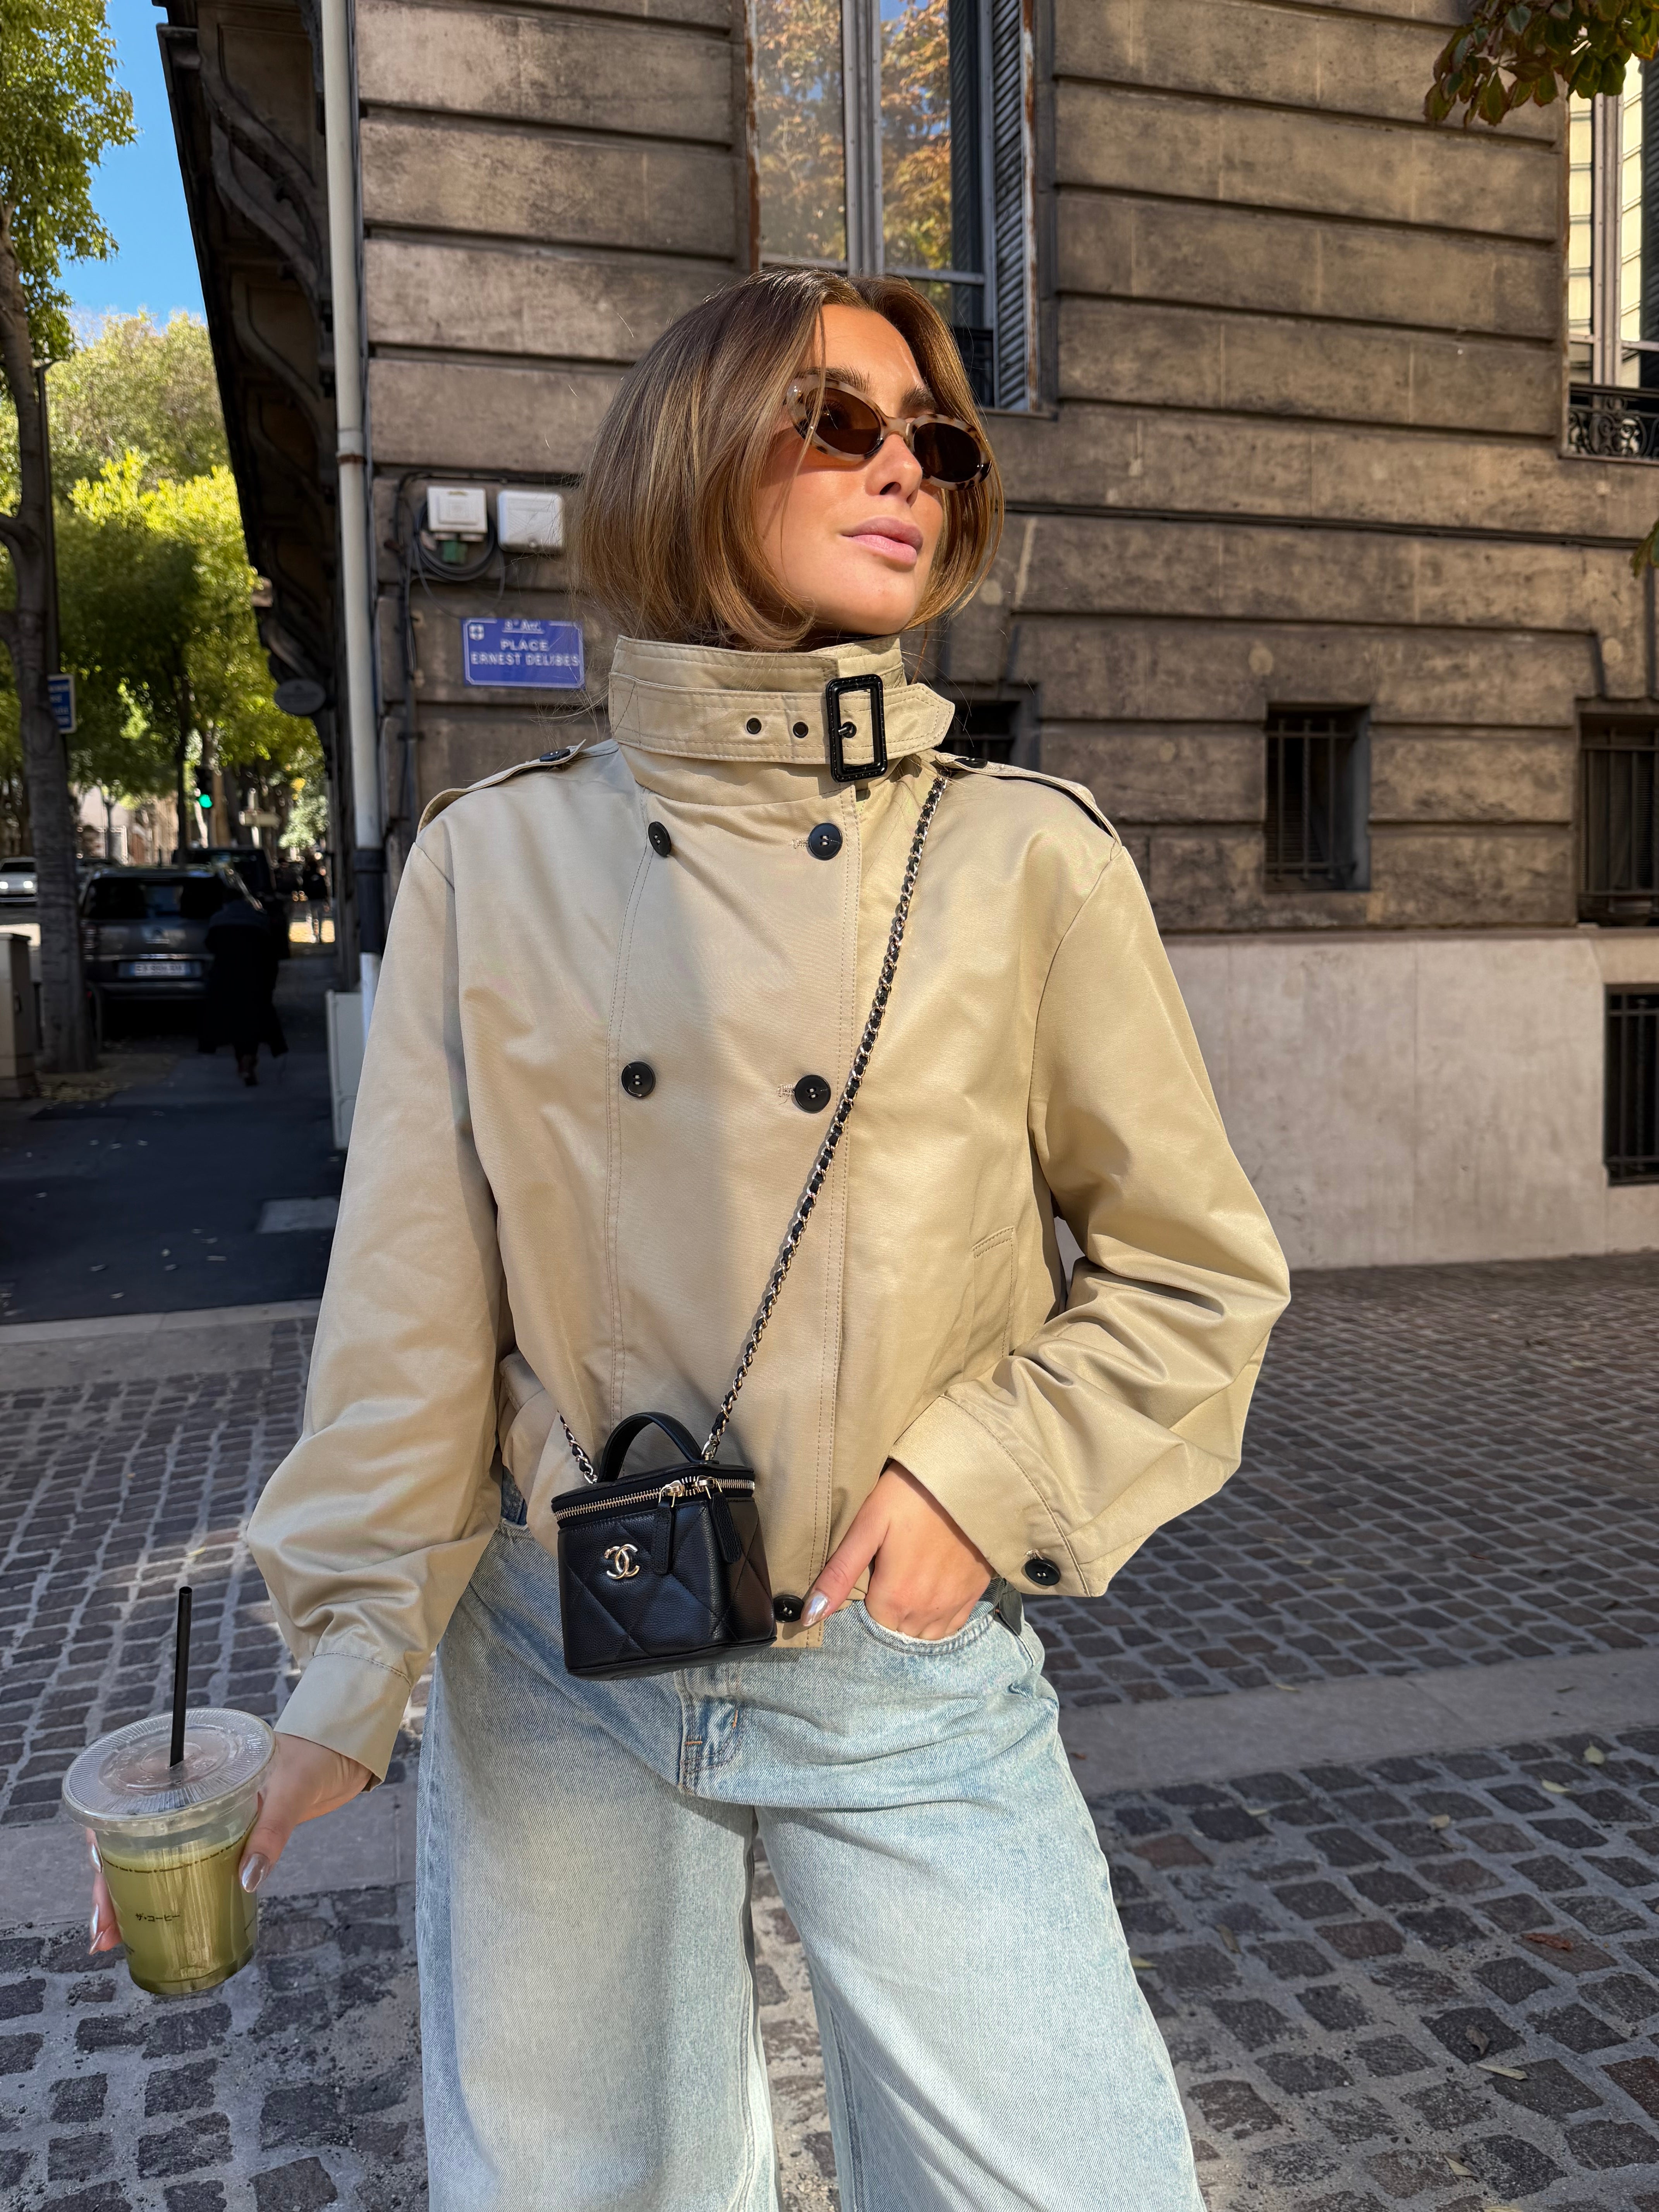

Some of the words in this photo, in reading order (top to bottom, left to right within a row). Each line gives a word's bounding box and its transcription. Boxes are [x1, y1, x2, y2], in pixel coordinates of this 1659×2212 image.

[500, 638, 550, 651] PLACE
[470, 651, 522, 665] ERNEST
[525, 653, 579, 666] DELIBES
